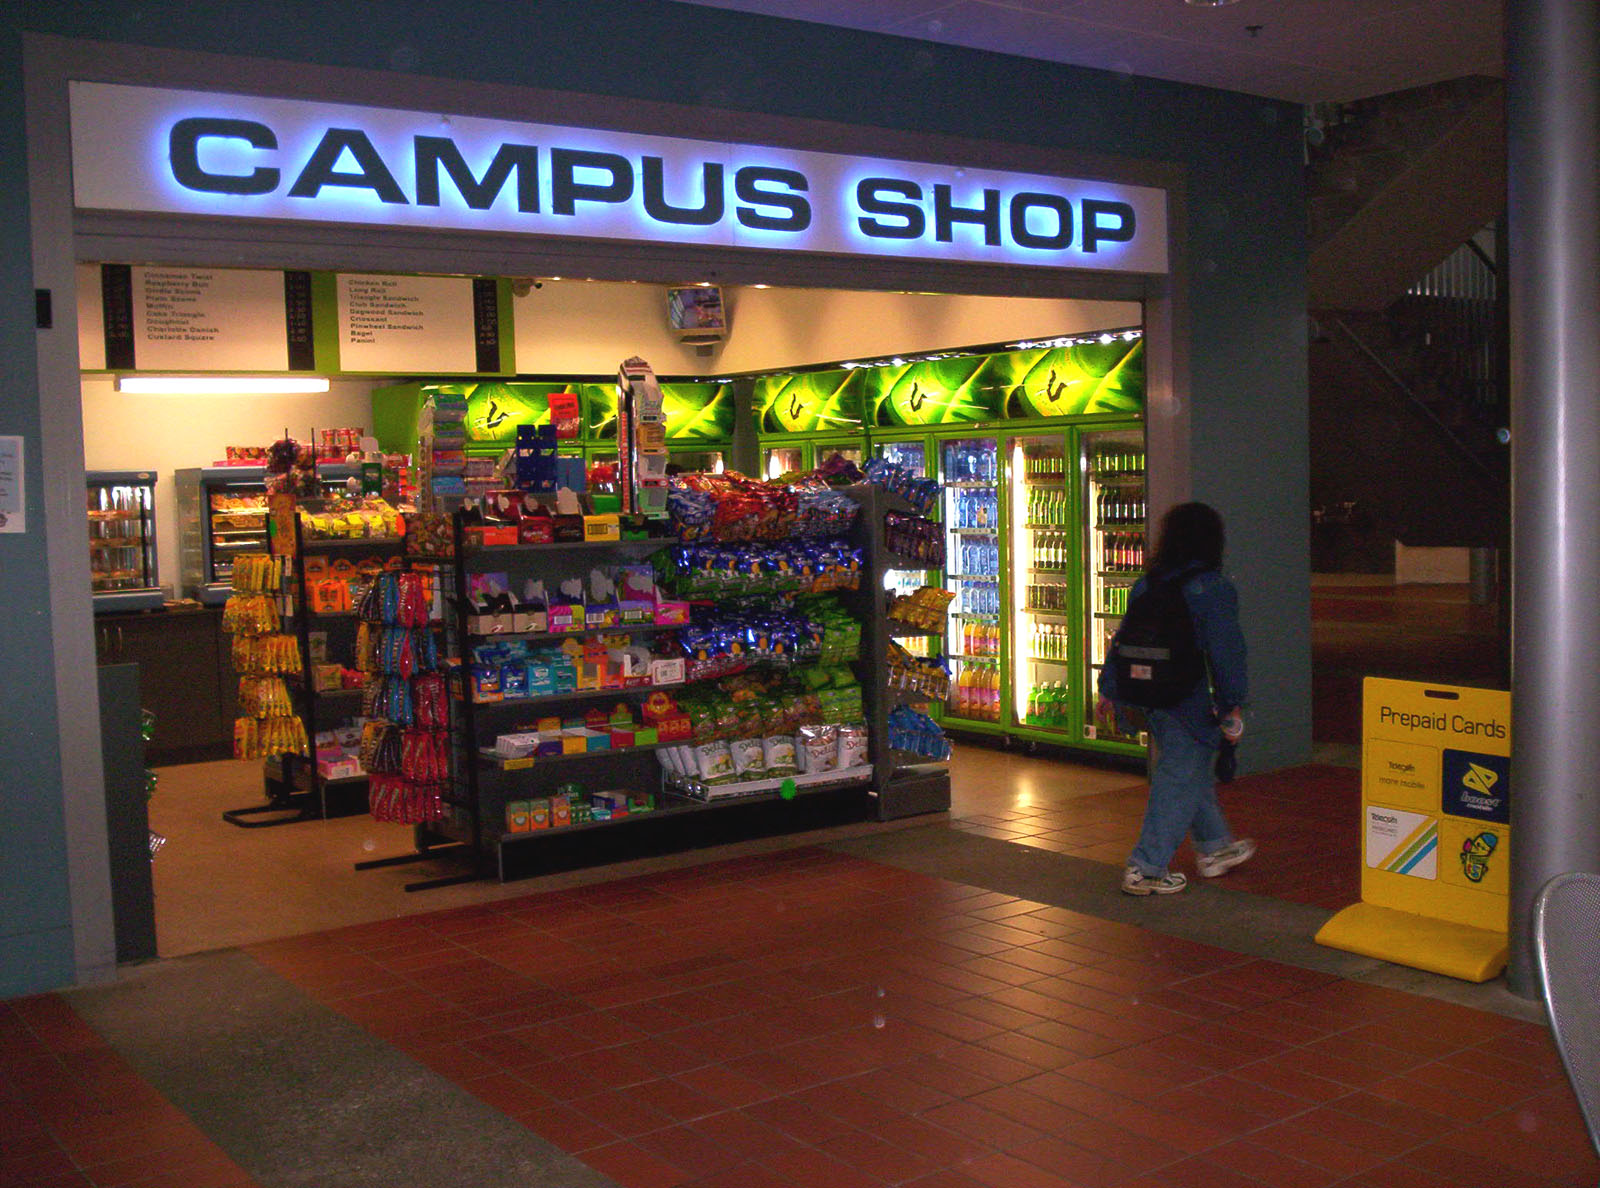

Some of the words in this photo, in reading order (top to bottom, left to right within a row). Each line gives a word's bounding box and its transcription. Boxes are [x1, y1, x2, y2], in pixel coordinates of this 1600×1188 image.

[169, 117, 811, 232] CAMPUS
[857, 178, 1135, 253] SHOP
[1380, 706, 1447, 731] Prepaid
[1452, 714, 1507, 739] Cards
[1379, 777, 1399, 785] more
